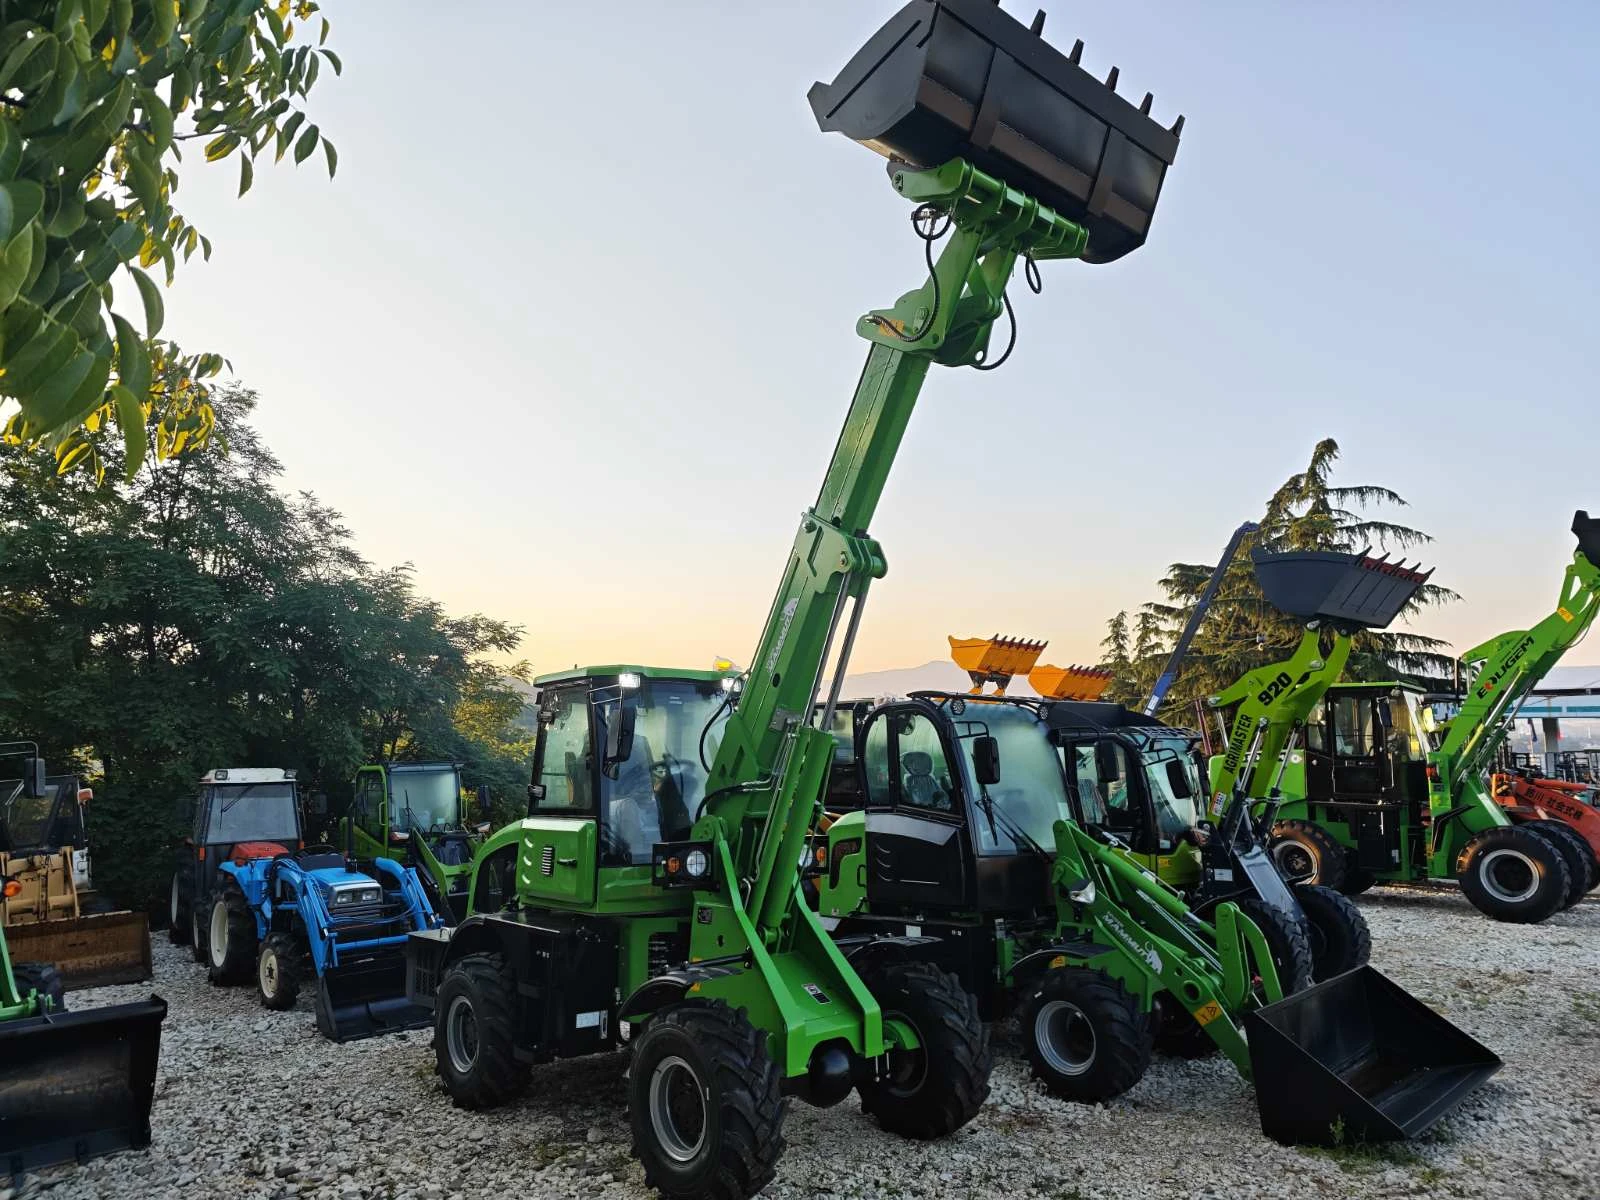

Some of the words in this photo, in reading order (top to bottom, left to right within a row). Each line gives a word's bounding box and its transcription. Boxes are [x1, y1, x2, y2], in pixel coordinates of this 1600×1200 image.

[1257, 671, 1293, 706] 920
[1223, 713, 1253, 775] AGRIMASTER
[1102, 914, 1148, 957] MAMMUT
